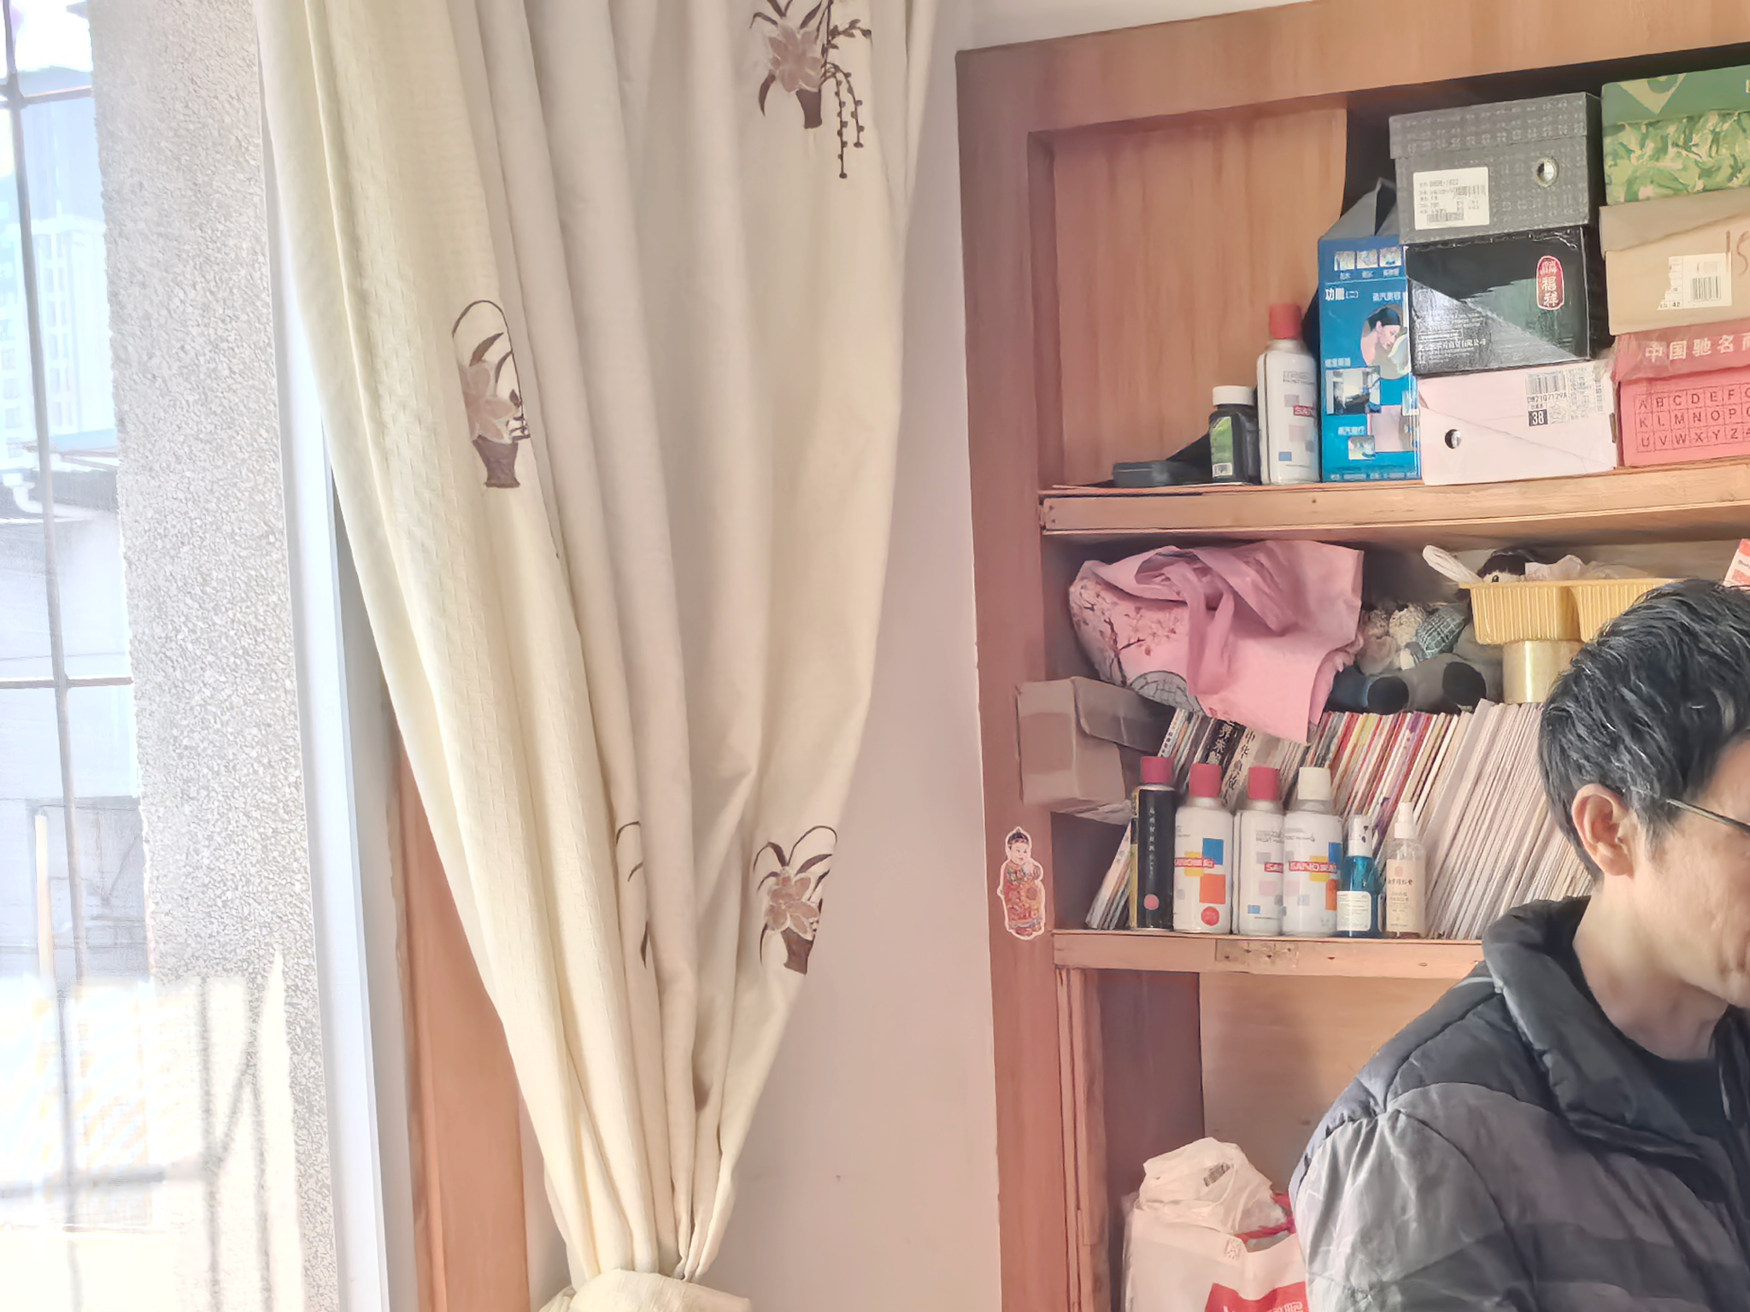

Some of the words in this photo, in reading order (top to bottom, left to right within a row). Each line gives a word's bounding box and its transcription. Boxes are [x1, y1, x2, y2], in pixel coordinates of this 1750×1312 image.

[1639, 399, 1648, 410] A
[1656, 397, 1664, 408] B
[1673, 394, 1682, 406] C
[1691, 393, 1700, 405] D
[1710, 390, 1718, 402] E
[1728, 389, 1735, 400] F
[1532, 411, 1544, 424] 38
[1639, 415, 1648, 428] K
[1657, 415, 1665, 426] L
[1674, 413, 1685, 425] M
[1693, 412, 1701, 423] N
[1710, 410, 1720, 421] O
[1729, 408, 1736, 419] P
[1641, 436, 1650, 447] U
[1659, 435, 1668, 446] V
[1675, 433, 1687, 445] W
[1695, 431, 1704, 443] X
[1712, 430, 1720, 441] Y
[1730, 428, 1738, 439] Z
